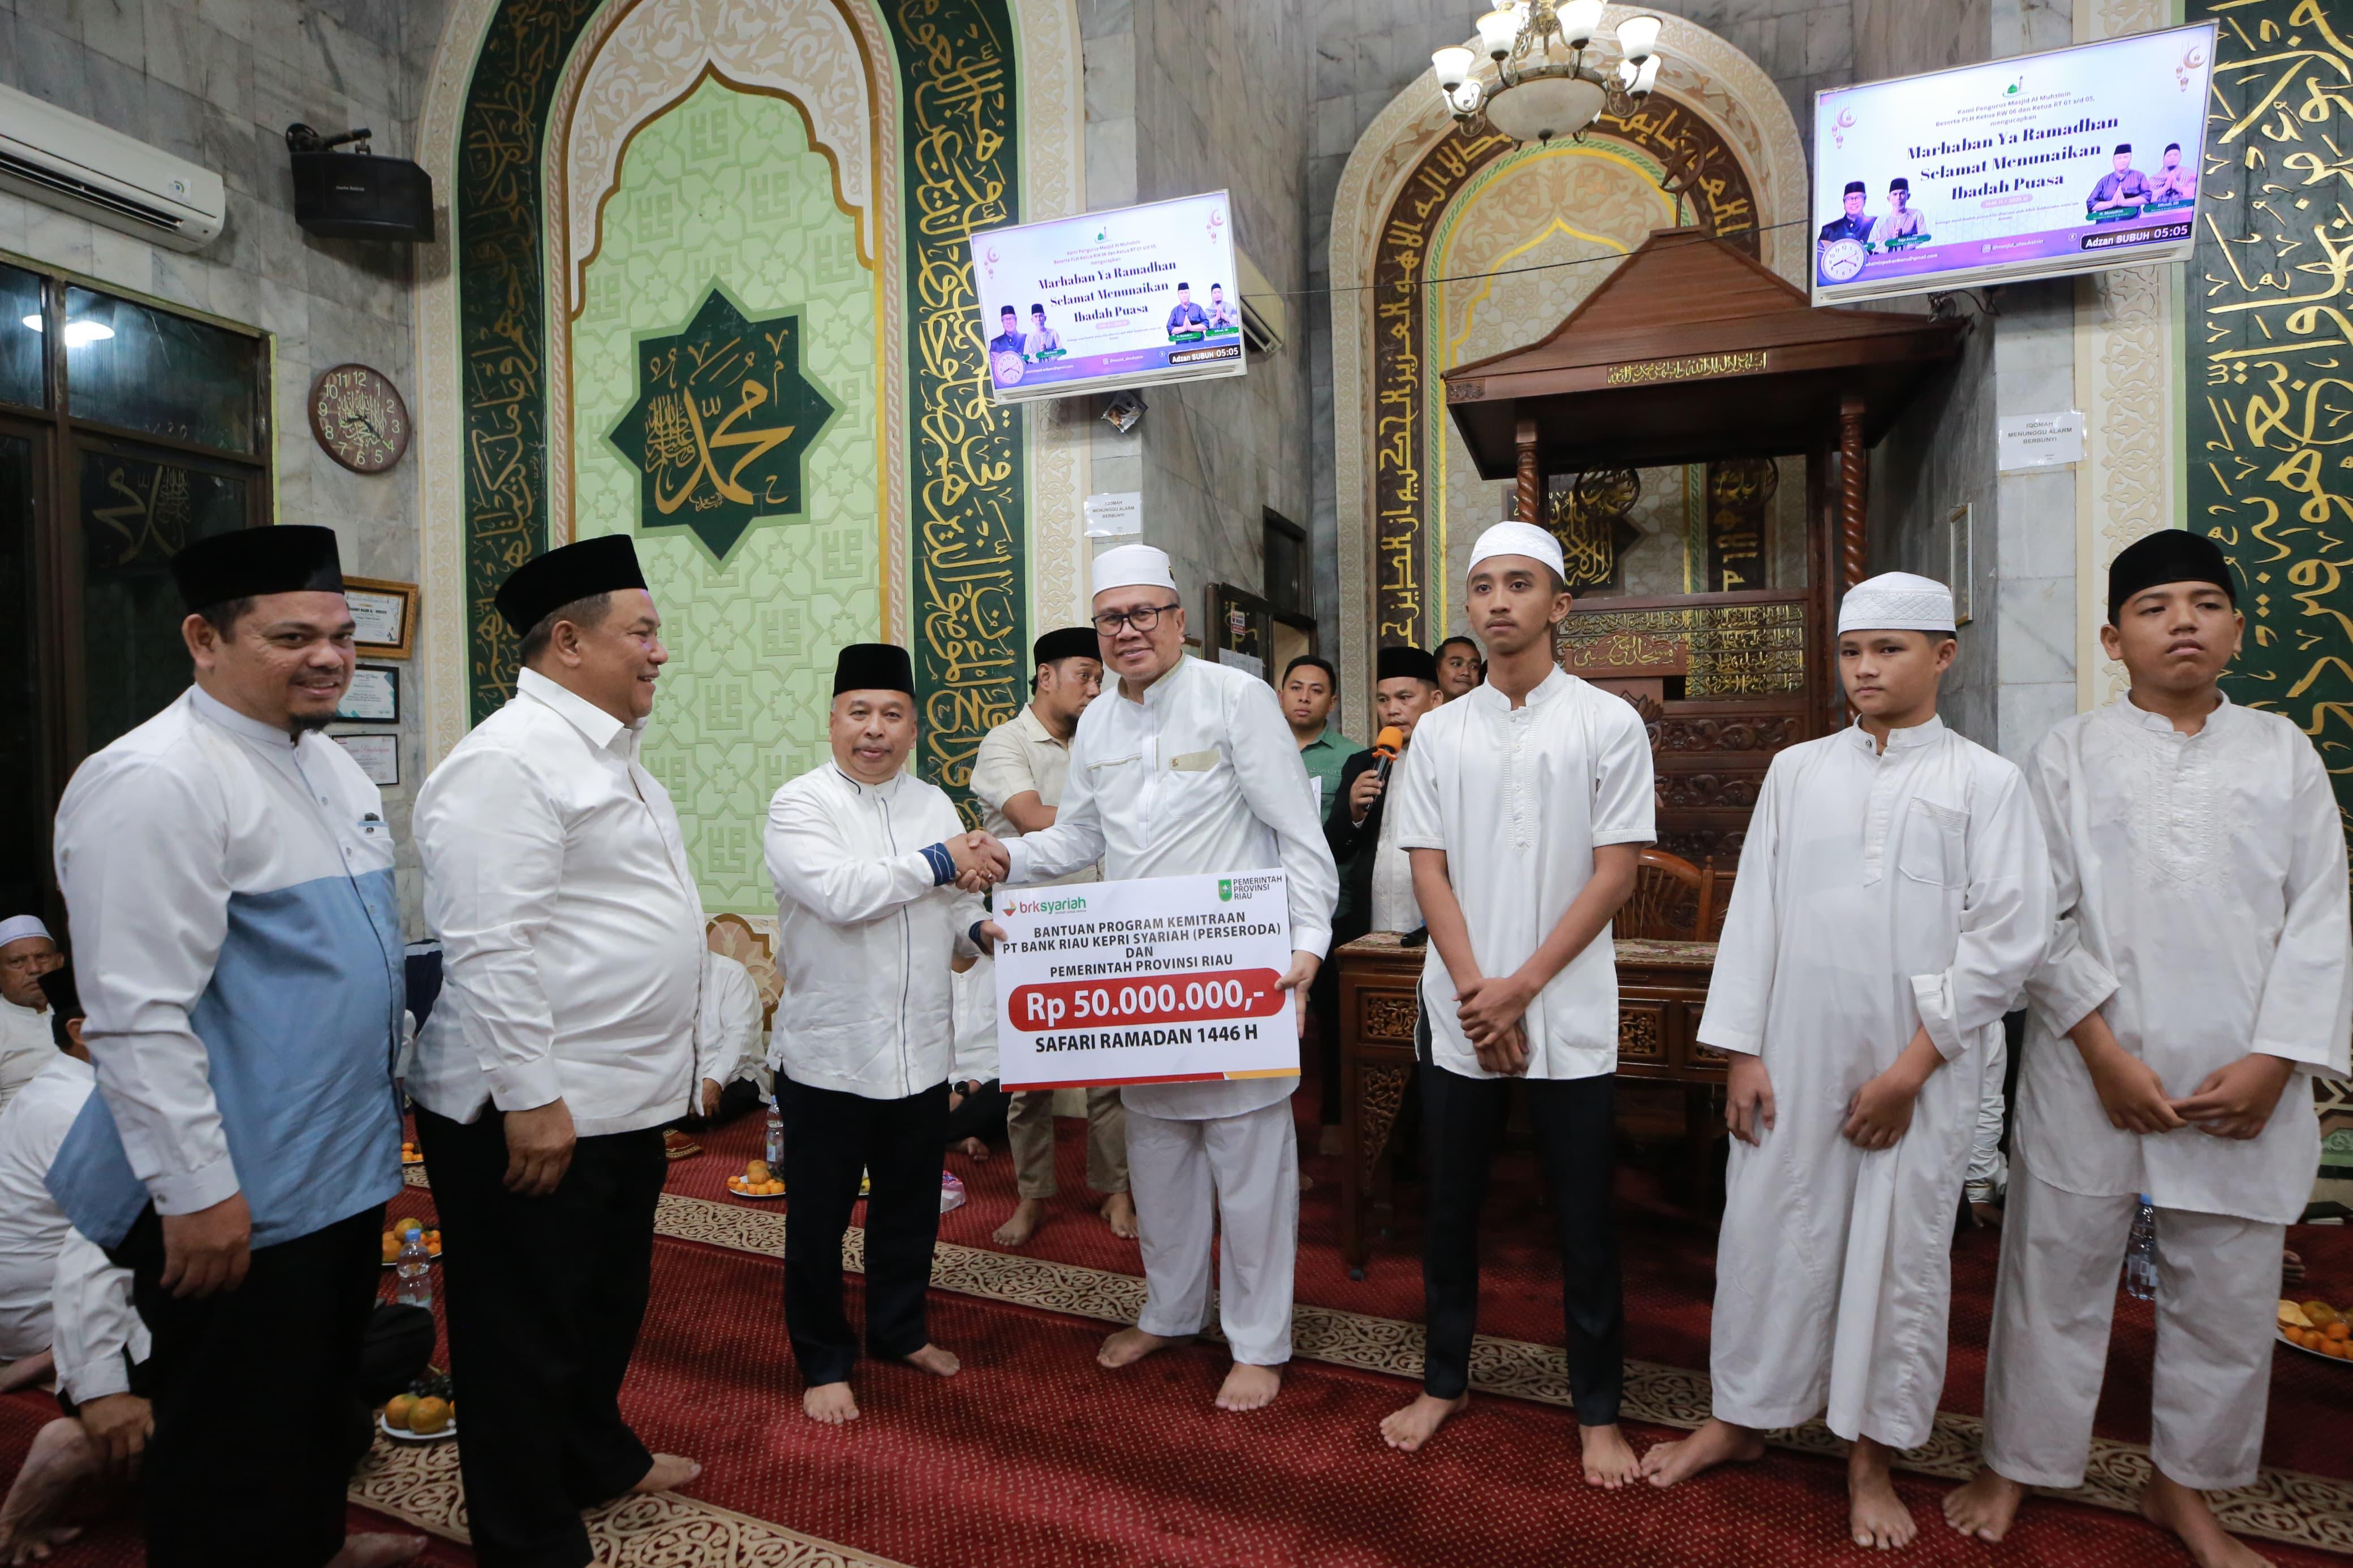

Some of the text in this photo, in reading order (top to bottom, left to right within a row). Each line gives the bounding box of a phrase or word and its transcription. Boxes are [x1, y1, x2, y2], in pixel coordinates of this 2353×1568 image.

[1976, 103, 2006, 113] Pengurus
[2008, 98, 2029, 107] Masjid
[2040, 91, 2071, 101] Muhsinin
[1936, 118, 1960, 127] Beserta
[1976, 112, 1995, 120] Ketua
[1990, 114, 2036, 127] mengucapkan
[1907, 118, 2119, 161] Marhaban Ya Ramadhan
[1920, 145, 2101, 182] Selamat Menunaikan
[1951, 175, 2064, 200] Ibadah Puasa
[2085, 236, 2114, 248] Adzan
[2115, 231, 2150, 244] SUBUH
[2154, 224, 2188, 238] 05:05
[1865, 253, 1938, 267] uhsininpekanbaru@gmail.com
[1038, 261, 1176, 290] Marhaban Ya Ramadhan
[1050, 282, 1169, 307] Selamat Menunaikan
[1074, 305, 1148, 323] Ibadah Puasa
[1172, 347, 1239, 363] Adzan SUBUH 05:05
[337, 372, 348, 388] 11
[353, 370, 367, 387] 12
[324, 382, 338, 399] 10
[375, 382, 381, 397] 1
[318, 402, 327, 417] 9
[386, 399, 394, 413] 2
[325, 425, 334, 440] 8
[391, 420, 399, 433] 3
[338, 442, 347, 456] 7
[383, 439, 395, 453] 4
[357, 451, 365, 465] 6
[375, 450, 383, 464] 5
[1233, 875, 1282, 886] PEMERINTAH
[1234, 883, 1270, 893] PROVINSI
[1234, 892, 1252, 900] RIAU
[1020, 896, 1086, 914] brksyariah
[1034, 912, 1245, 938] BANTUAN PROGRAM KEMITRAAN
[1003, 922, 1281, 954] PT BANK RIAU KEPRI SYARIAH (PERSERODA)
[1126, 946, 1153, 958] DAN
[1050, 954, 1232, 978] PEMERINTAH PROVINSI RIAU
[1026, 979, 1265, 1027] Rp 50.000.000,-
[1035, 1023, 1258, 1053] SAFARI RAMADAN 1446 H
